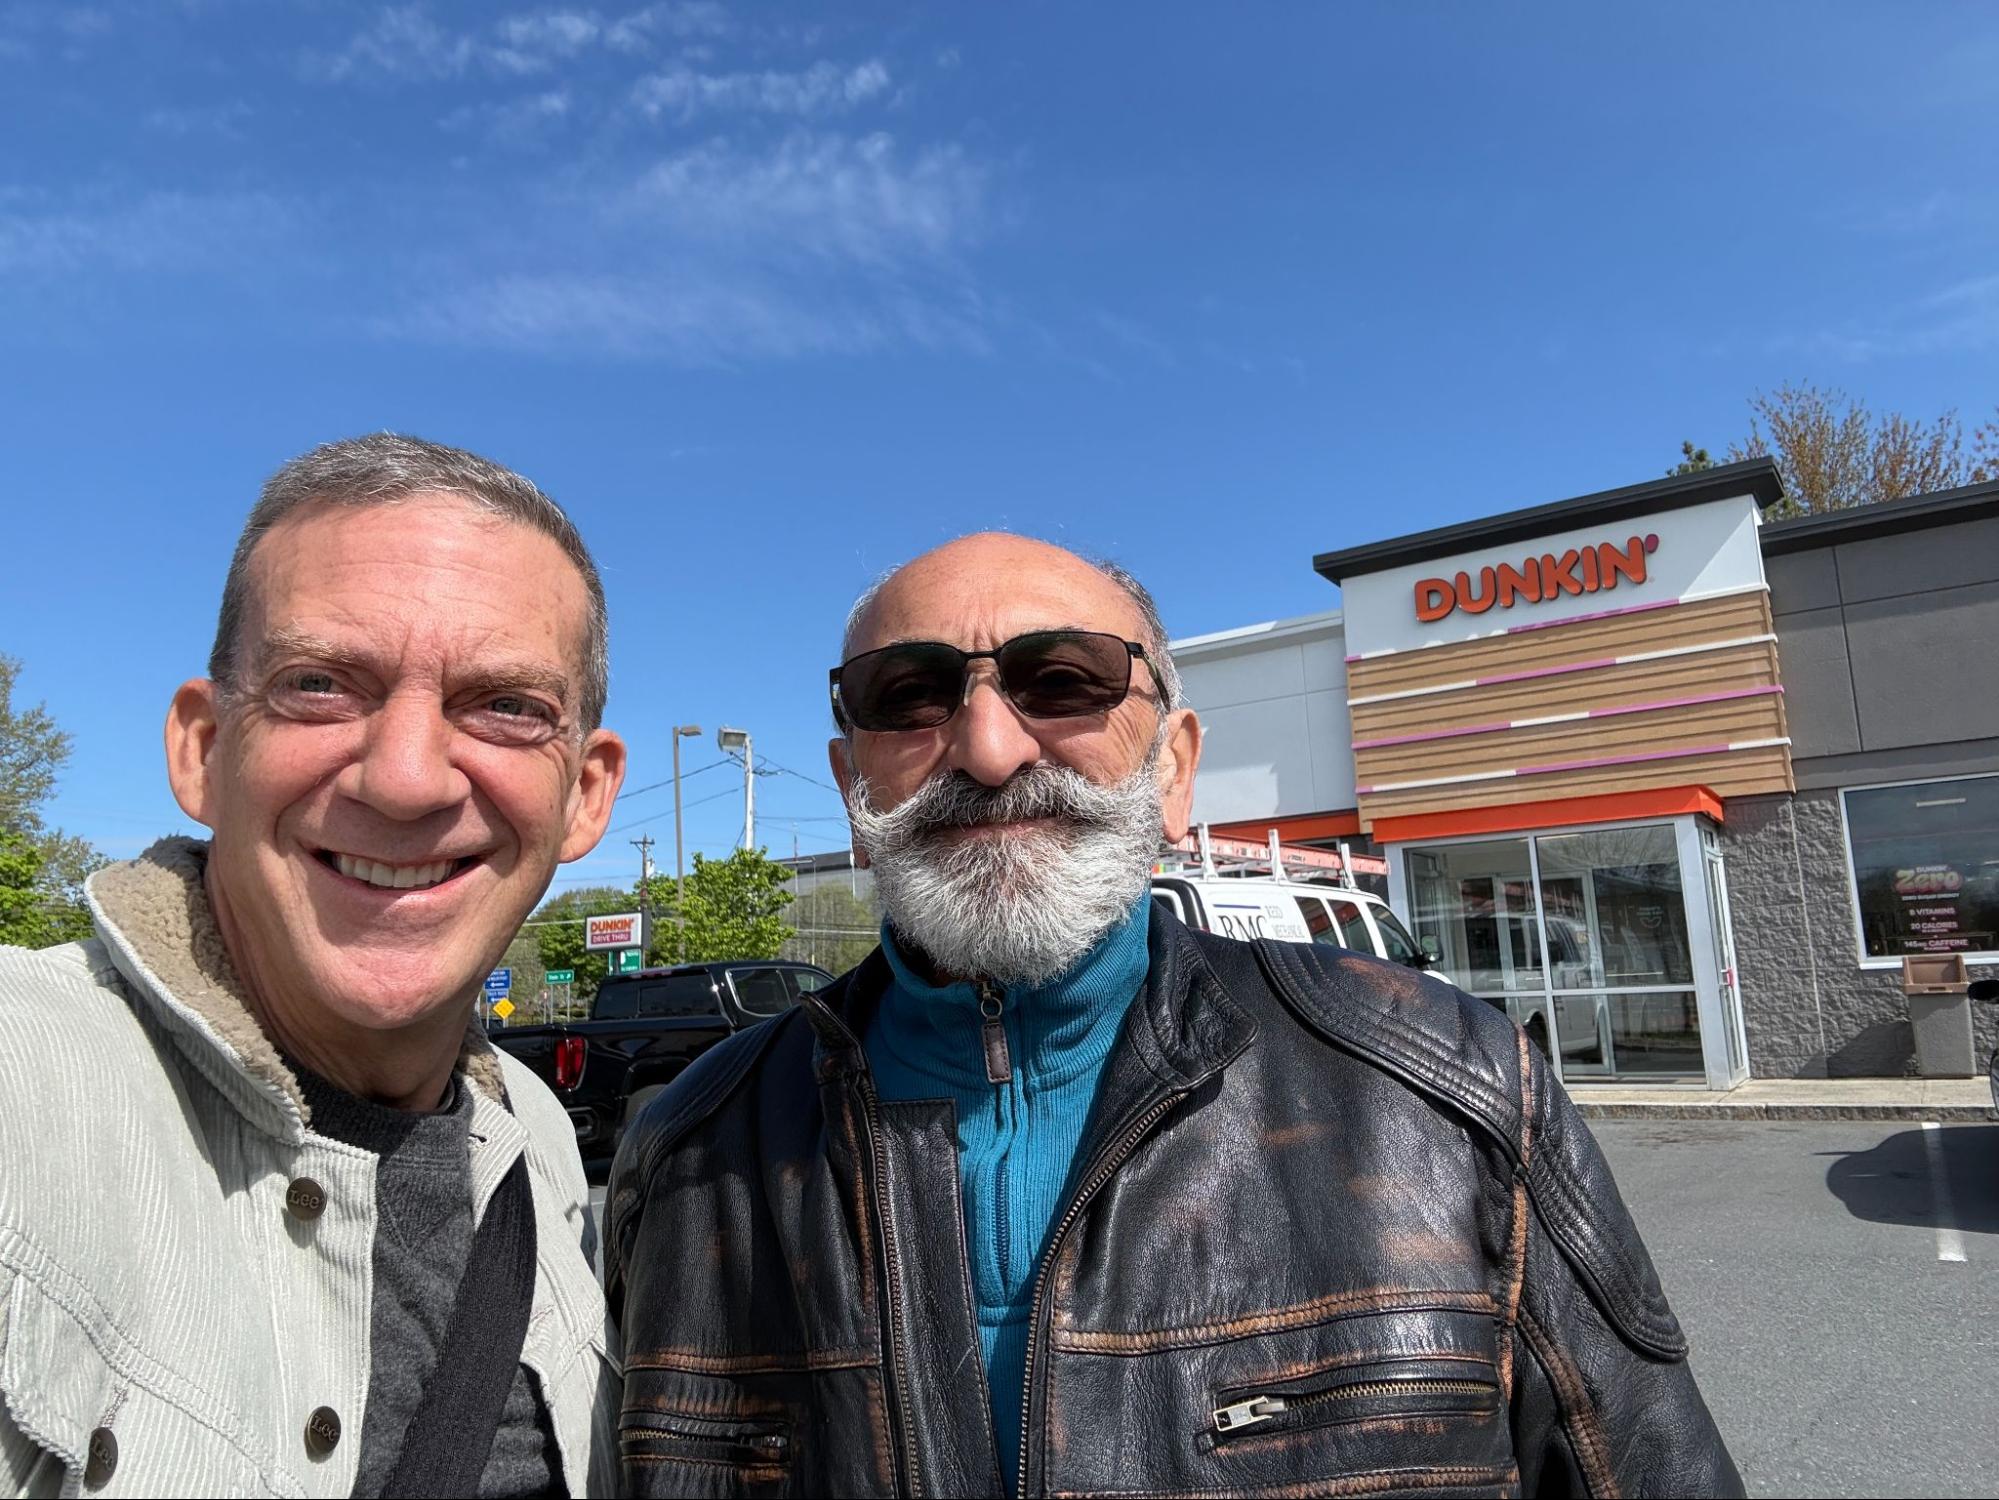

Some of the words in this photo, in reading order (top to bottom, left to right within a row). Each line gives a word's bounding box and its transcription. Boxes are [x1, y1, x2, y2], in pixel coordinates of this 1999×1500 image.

[1413, 533, 1660, 623] DUNKIN'
[1895, 869, 1961, 892] Zero
[1916, 907, 1955, 915] VITAMINS
[1921, 921, 1959, 929] CALORIES
[592, 935, 610, 944] DRIVE
[612, 933, 629, 941] THRU
[1928, 939, 1969, 947] CAFFEINE
[289, 1190, 320, 1209] Lee
[312, 1415, 338, 1442] Lee
